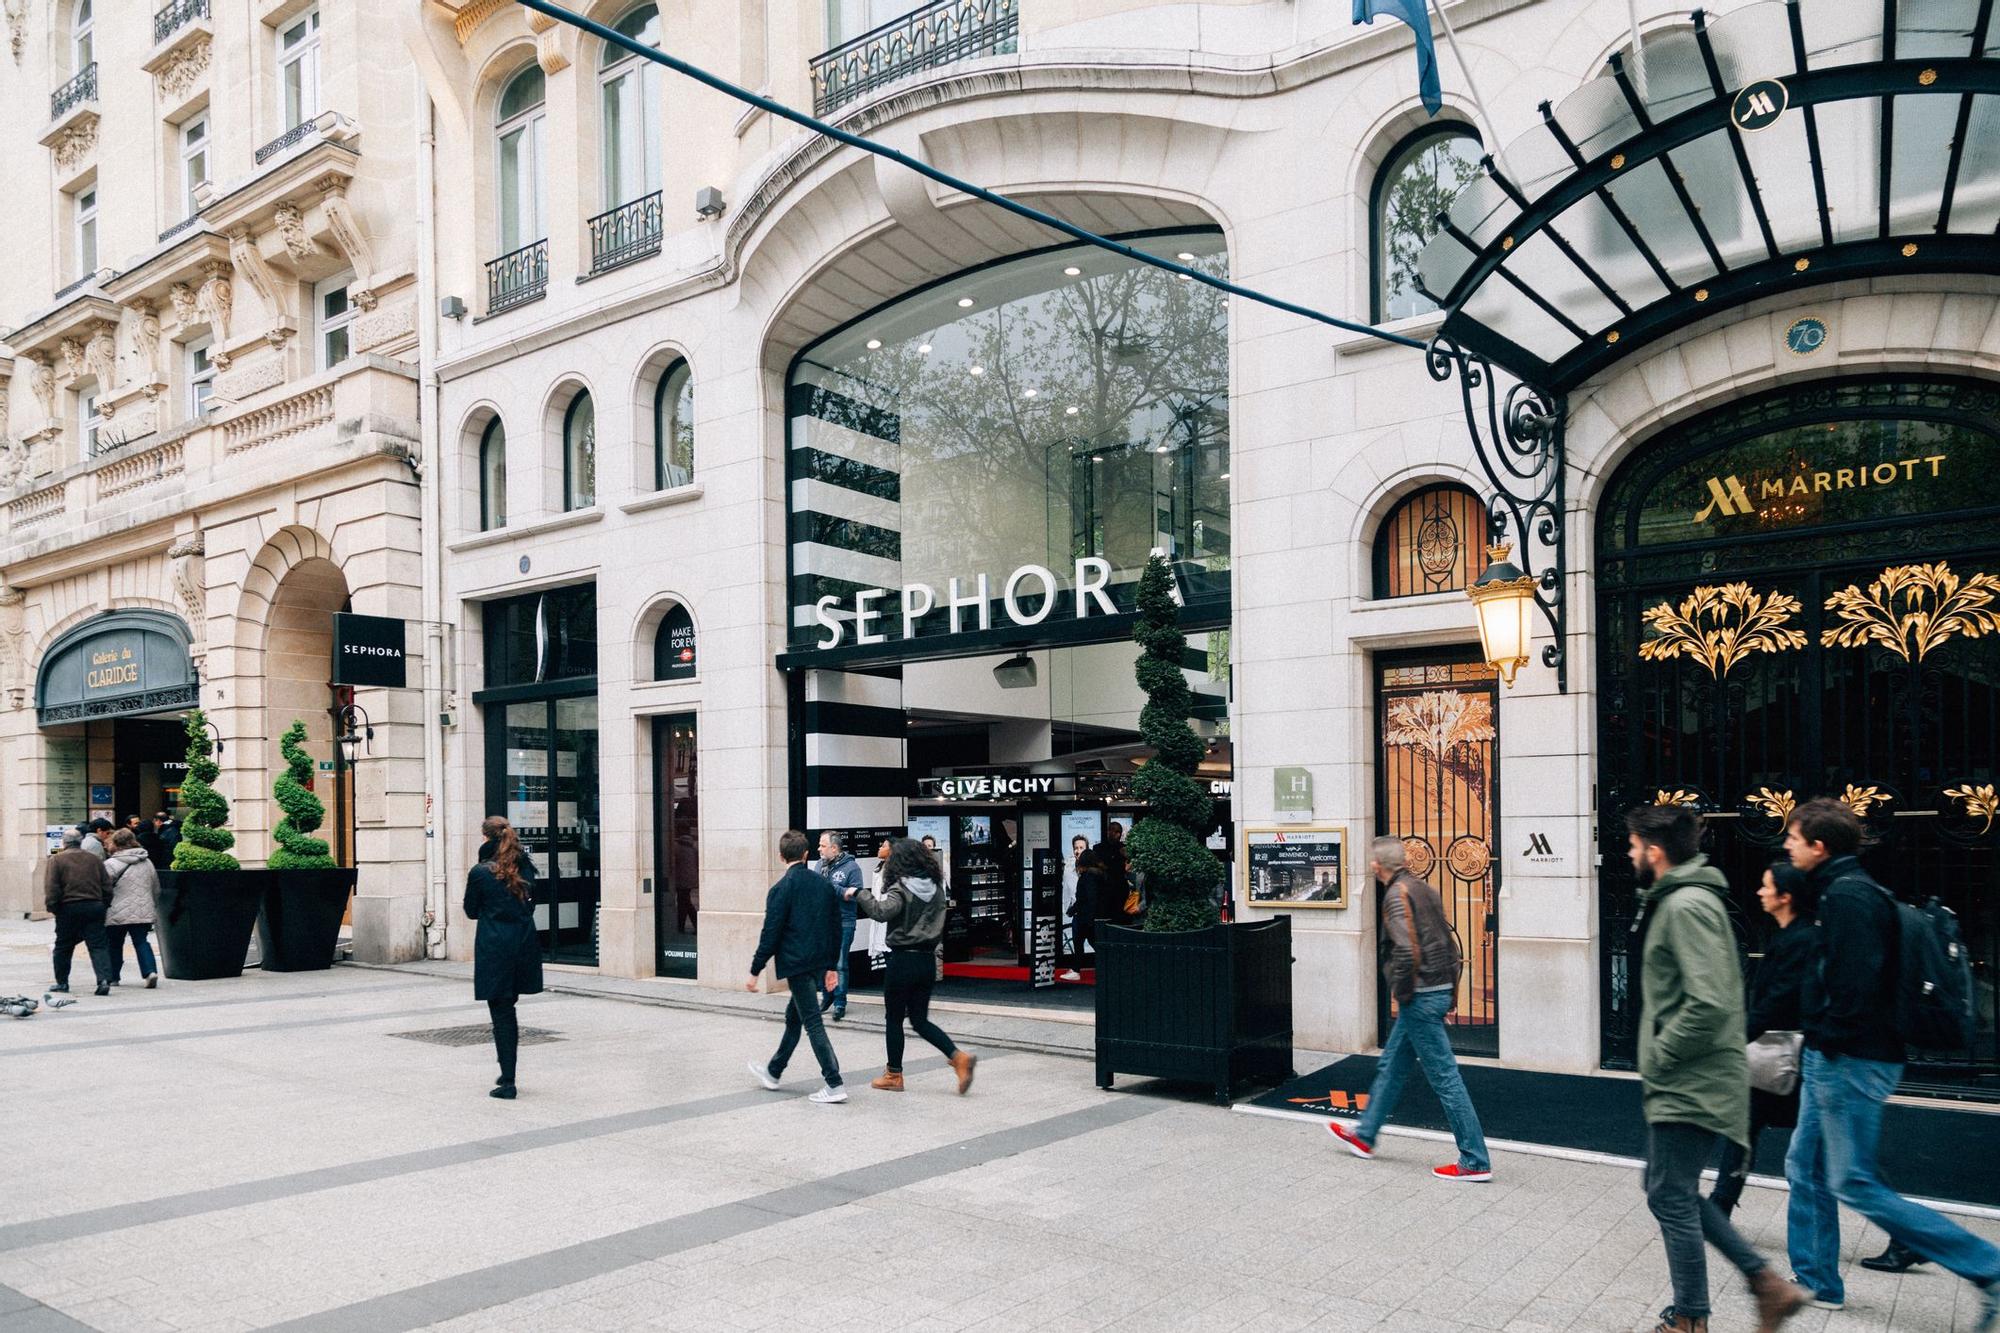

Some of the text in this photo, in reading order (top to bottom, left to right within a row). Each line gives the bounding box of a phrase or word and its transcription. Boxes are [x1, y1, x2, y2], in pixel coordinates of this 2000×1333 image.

[1792, 323, 1825, 351] 70
[1761, 454, 1947, 499] MARRIOTT
[671, 626, 691, 638] MAKE
[344, 645, 401, 657] SEPHORA
[671, 638, 685, 648] FOR
[92, 649, 118, 665] Galerie
[87, 663, 138, 688] CLARIDGE
[941, 778, 1052, 795] GIVENCHY
[1291, 776, 1307, 792] H
[664, 950, 684, 958] VOLUME
